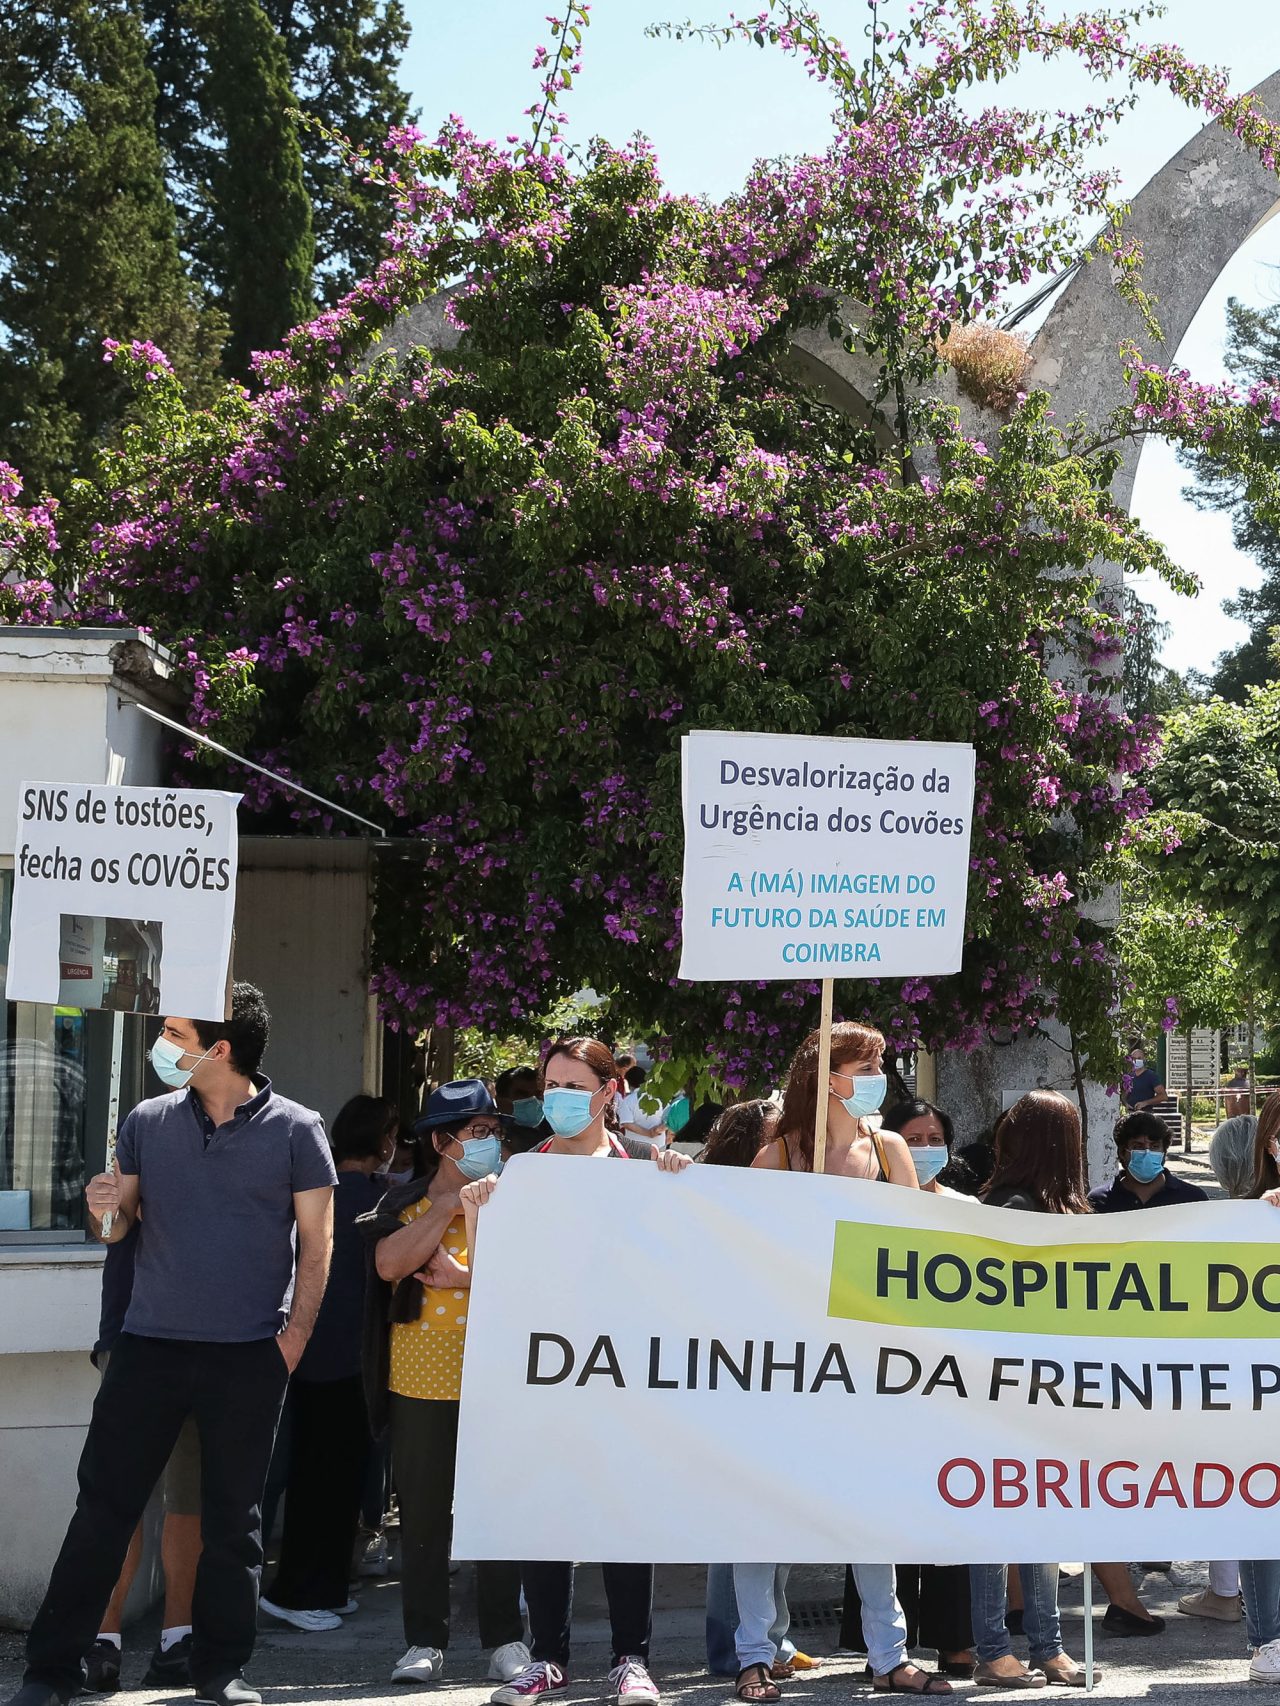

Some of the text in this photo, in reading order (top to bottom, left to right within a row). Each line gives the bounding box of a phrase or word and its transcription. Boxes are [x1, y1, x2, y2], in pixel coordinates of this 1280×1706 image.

[721, 760, 949, 796] Desvalorização da
[23, 789, 212, 836] SNS de tostões,
[701, 804, 963, 835] Urgência dos Covões
[20, 844, 229, 891] fecha os COVÕES
[728, 868, 935, 898] A (MÁ) IMAGEM DO
[712, 904, 945, 928] FUTURO DA SAÚDE EM
[783, 943, 880, 963] COIMBRA
[877, 1248, 1188, 1311] HOSPITAL
[527, 1333, 626, 1387] DA
[648, 1337, 856, 1393] LINHA
[877, 1347, 968, 1398] DA
[989, 1358, 1231, 1410] FRENTE
